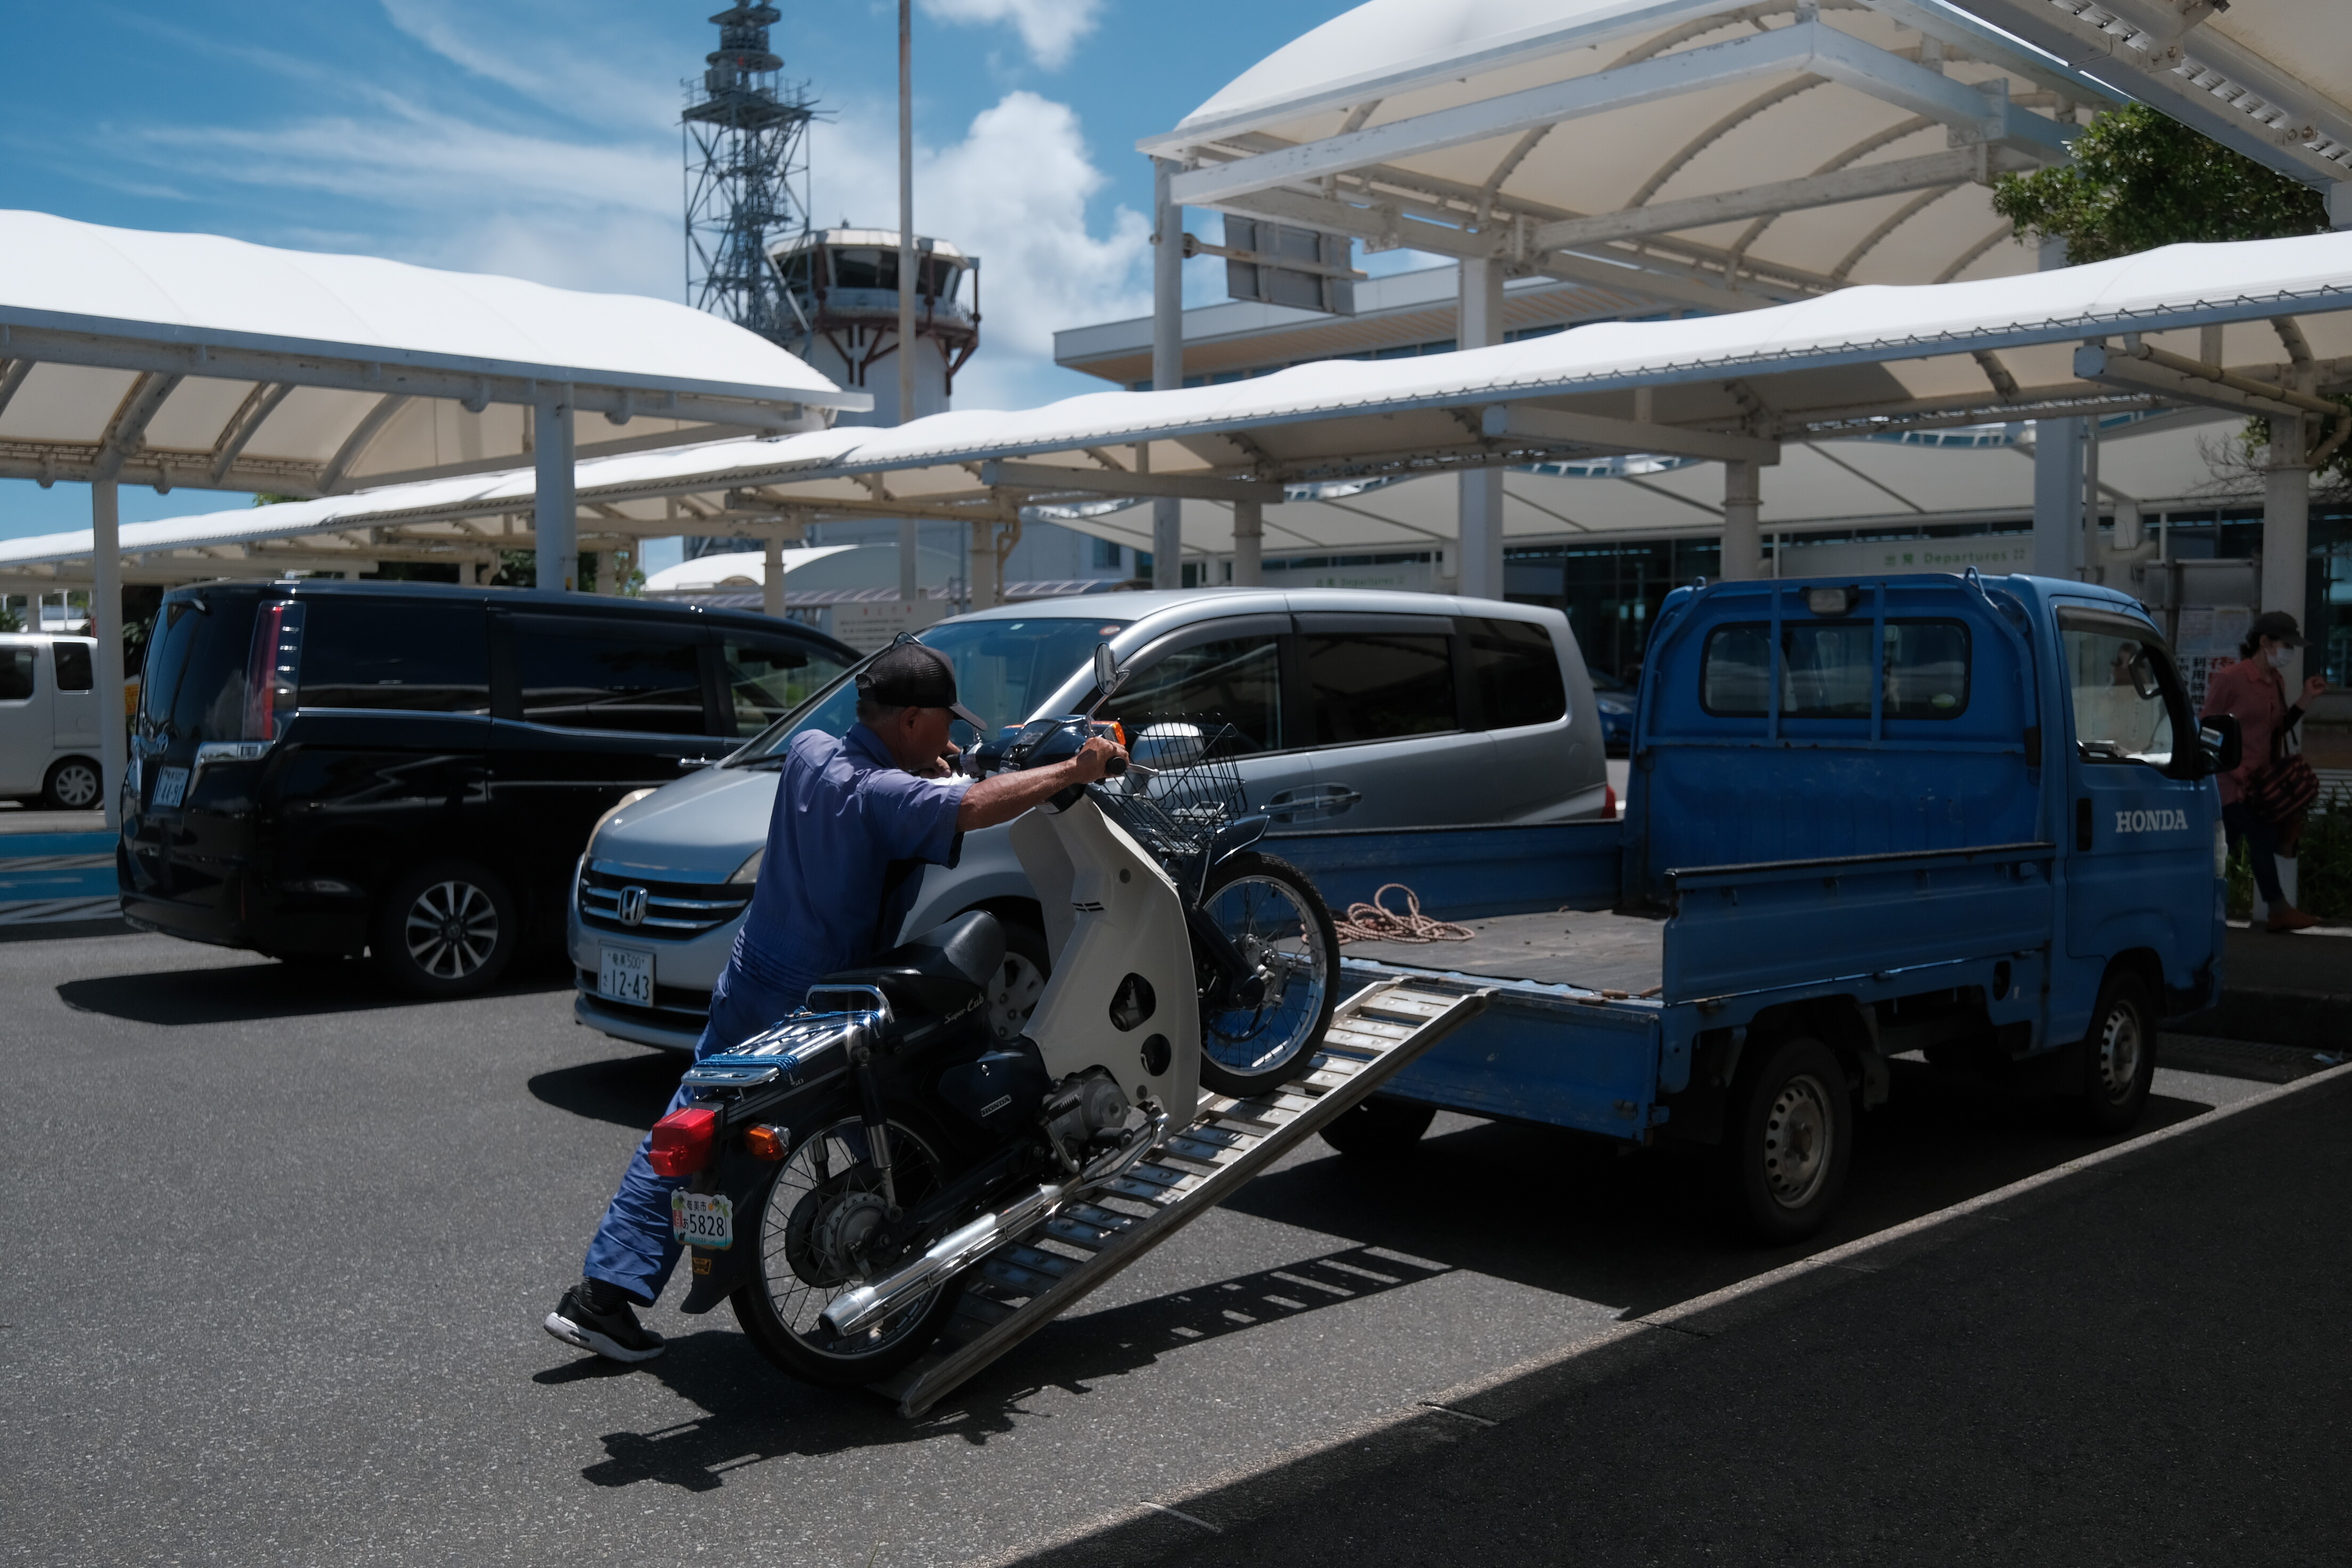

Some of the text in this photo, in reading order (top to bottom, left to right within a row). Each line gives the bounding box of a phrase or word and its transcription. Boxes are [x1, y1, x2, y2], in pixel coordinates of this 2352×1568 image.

[1924, 551, 2008, 565] Departures
[2115, 808, 2189, 834] HONDA
[944, 992, 984, 1025] Super Cub
[981, 1097, 1011, 1116] HONDA
[687, 1200, 707, 1212] 奄美市
[683, 1214, 724, 1237] あ 5828
